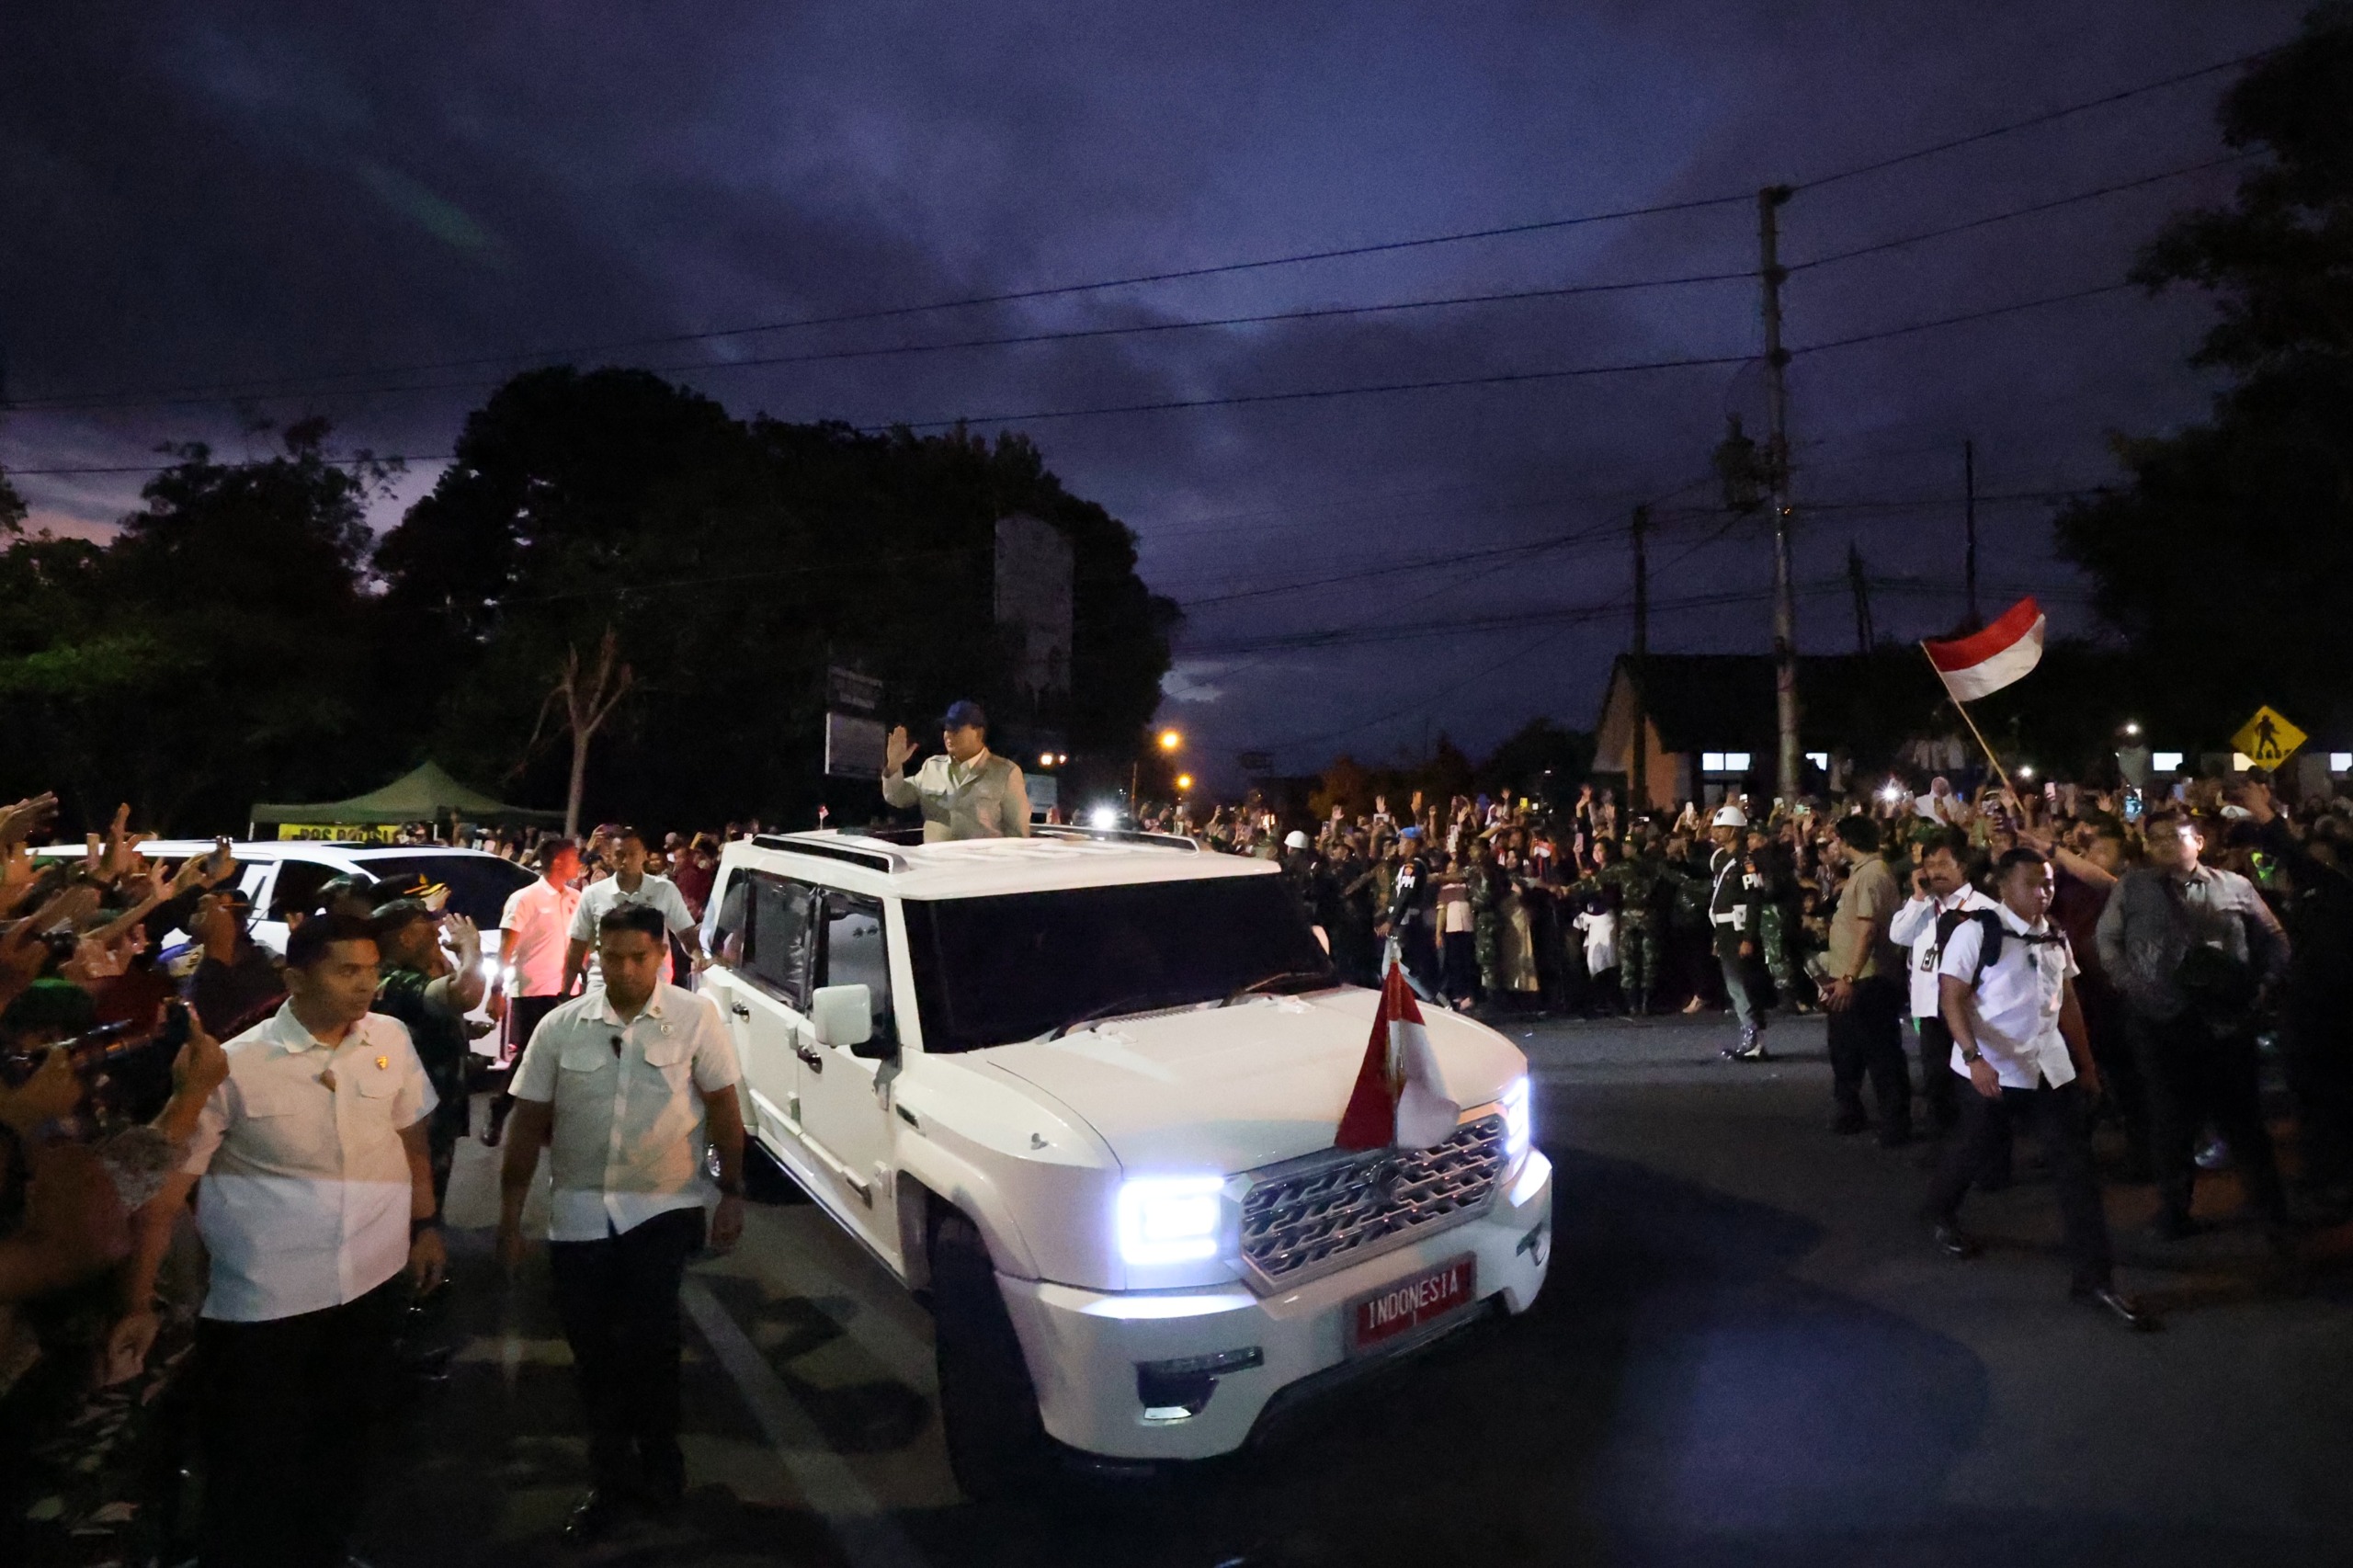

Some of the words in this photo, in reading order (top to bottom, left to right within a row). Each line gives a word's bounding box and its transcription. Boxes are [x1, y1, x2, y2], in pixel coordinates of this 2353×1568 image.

[1400, 875, 1415, 889] PM
[1742, 872, 1764, 890] PM
[1369, 1269, 1458, 1329] INDONESIA
